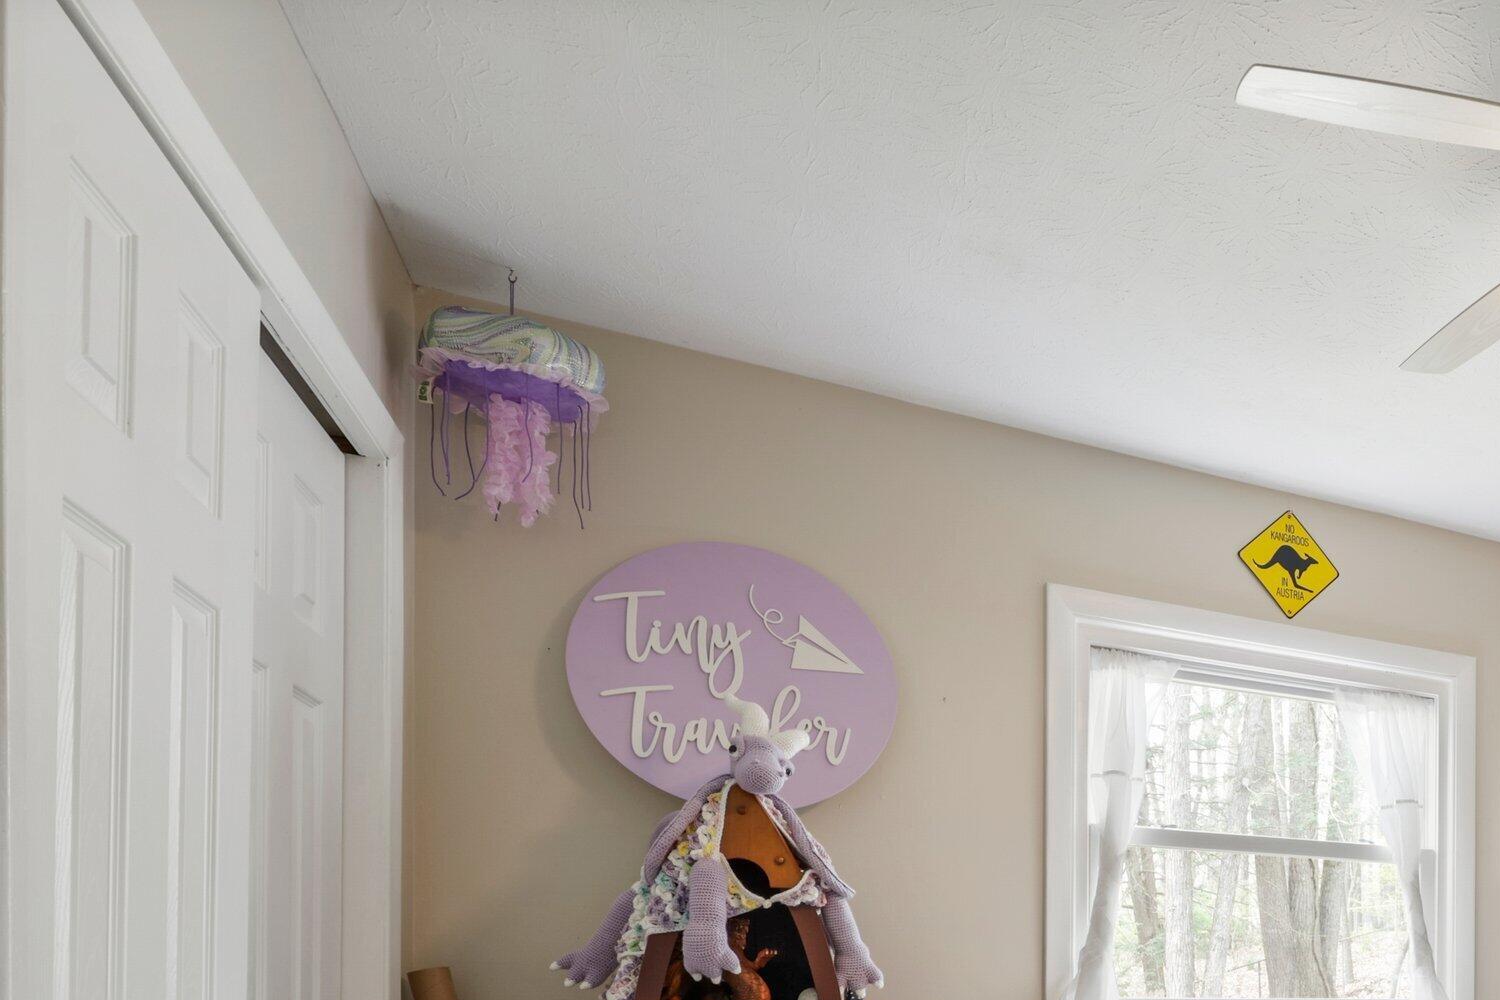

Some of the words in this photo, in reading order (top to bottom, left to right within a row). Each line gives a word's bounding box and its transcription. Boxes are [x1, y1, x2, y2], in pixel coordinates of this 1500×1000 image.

[1285, 523, 1295, 534] NO
[1270, 531, 1310, 547] KANGAROOS
[1281, 577, 1289, 587] IN
[1276, 587, 1305, 601] AUSTRIA
[593, 590, 751, 699] Tiny
[600, 685, 852, 766] Travler
